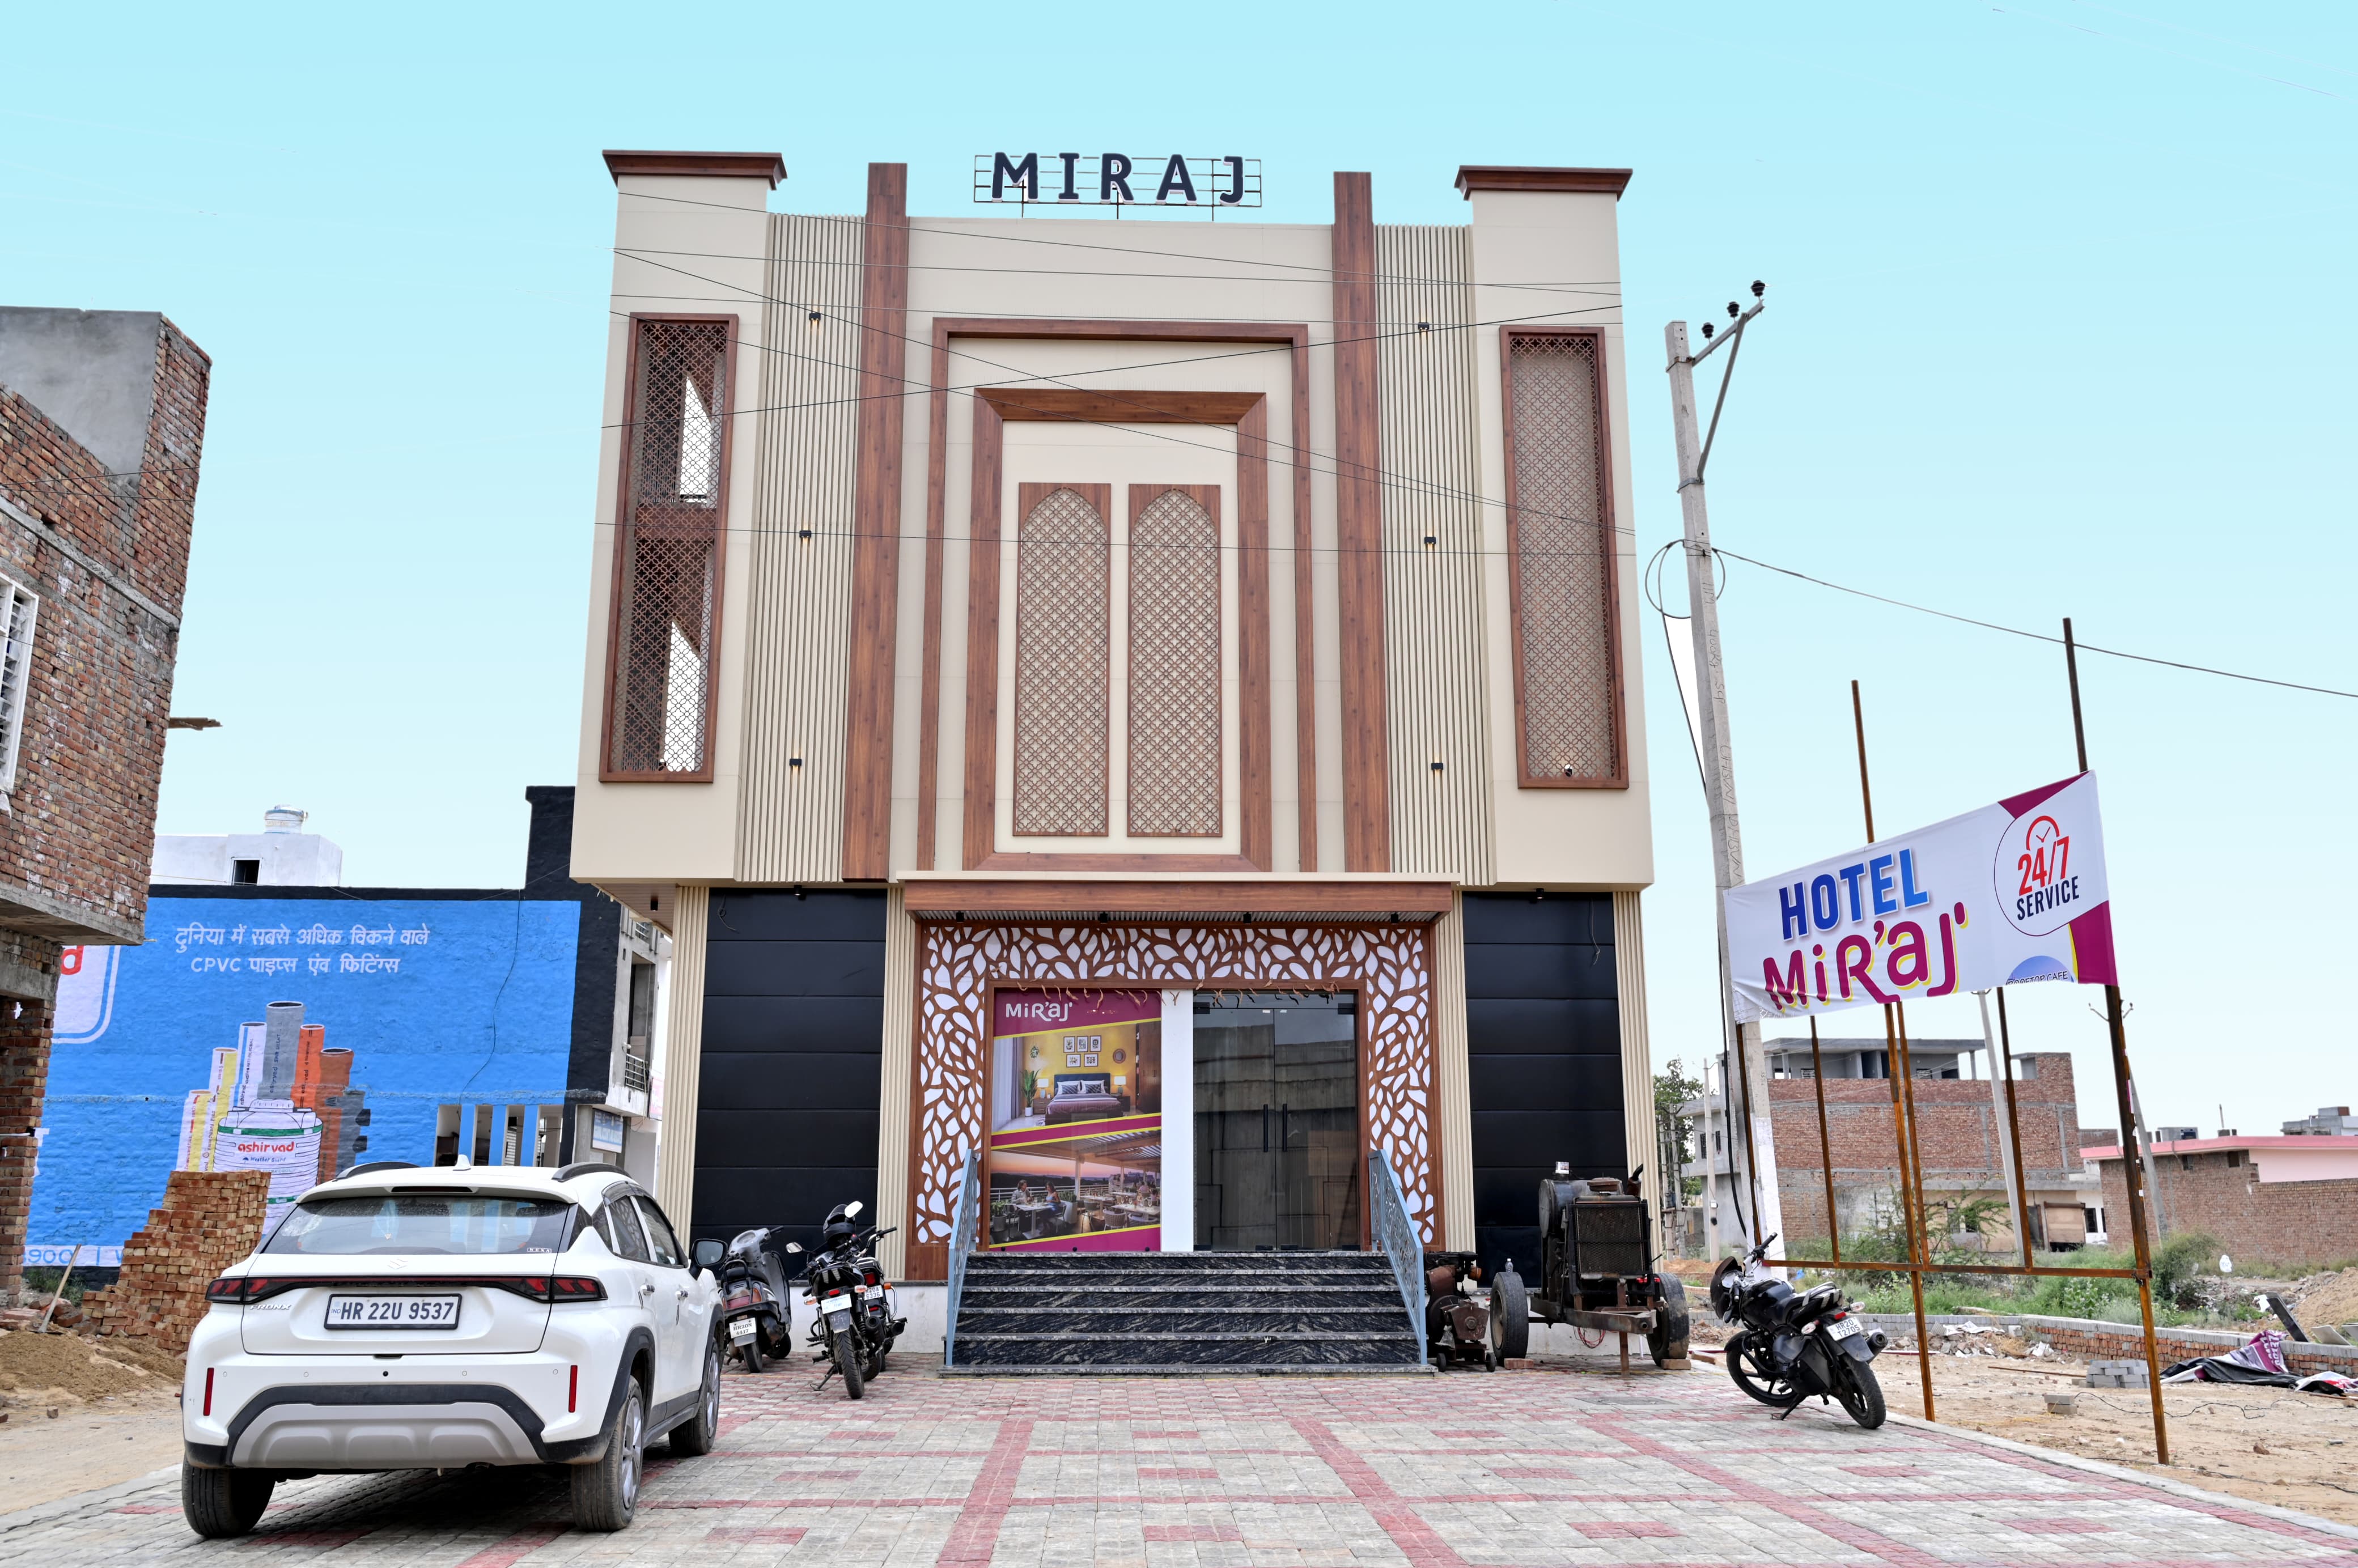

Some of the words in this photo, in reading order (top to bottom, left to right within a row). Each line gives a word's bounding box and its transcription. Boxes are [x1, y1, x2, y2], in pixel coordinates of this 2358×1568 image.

[991, 152, 1244, 206] MIRAJ
[2018, 835, 2069, 896] 24/7
[1778, 847, 1929, 941] HOTEL
[2016, 876, 2080, 921] SERVICE
[175, 921, 226, 953] दुनिया
[230, 923, 247, 945] में
[252, 923, 290, 946] सबसे
[296, 924, 342, 945] अधिक
[350, 924, 395, 945] विकने
[400, 923, 430, 945] वाले
[191, 957, 241, 972] CPVC
[249, 957, 298, 976] पाइप्स
[2047, 971, 2068, 981] CAFE
[238, 1141, 294, 1152] ashirvad
[23, 1248, 73, 1264] 900
[341, 1302, 363, 1320] HR
[368, 1302, 402, 1320] 22U
[409, 1302, 453, 1320] 9537
[1835, 1319, 1854, 1331] HR20
[1837, 1324, 1860, 1337] T2705
